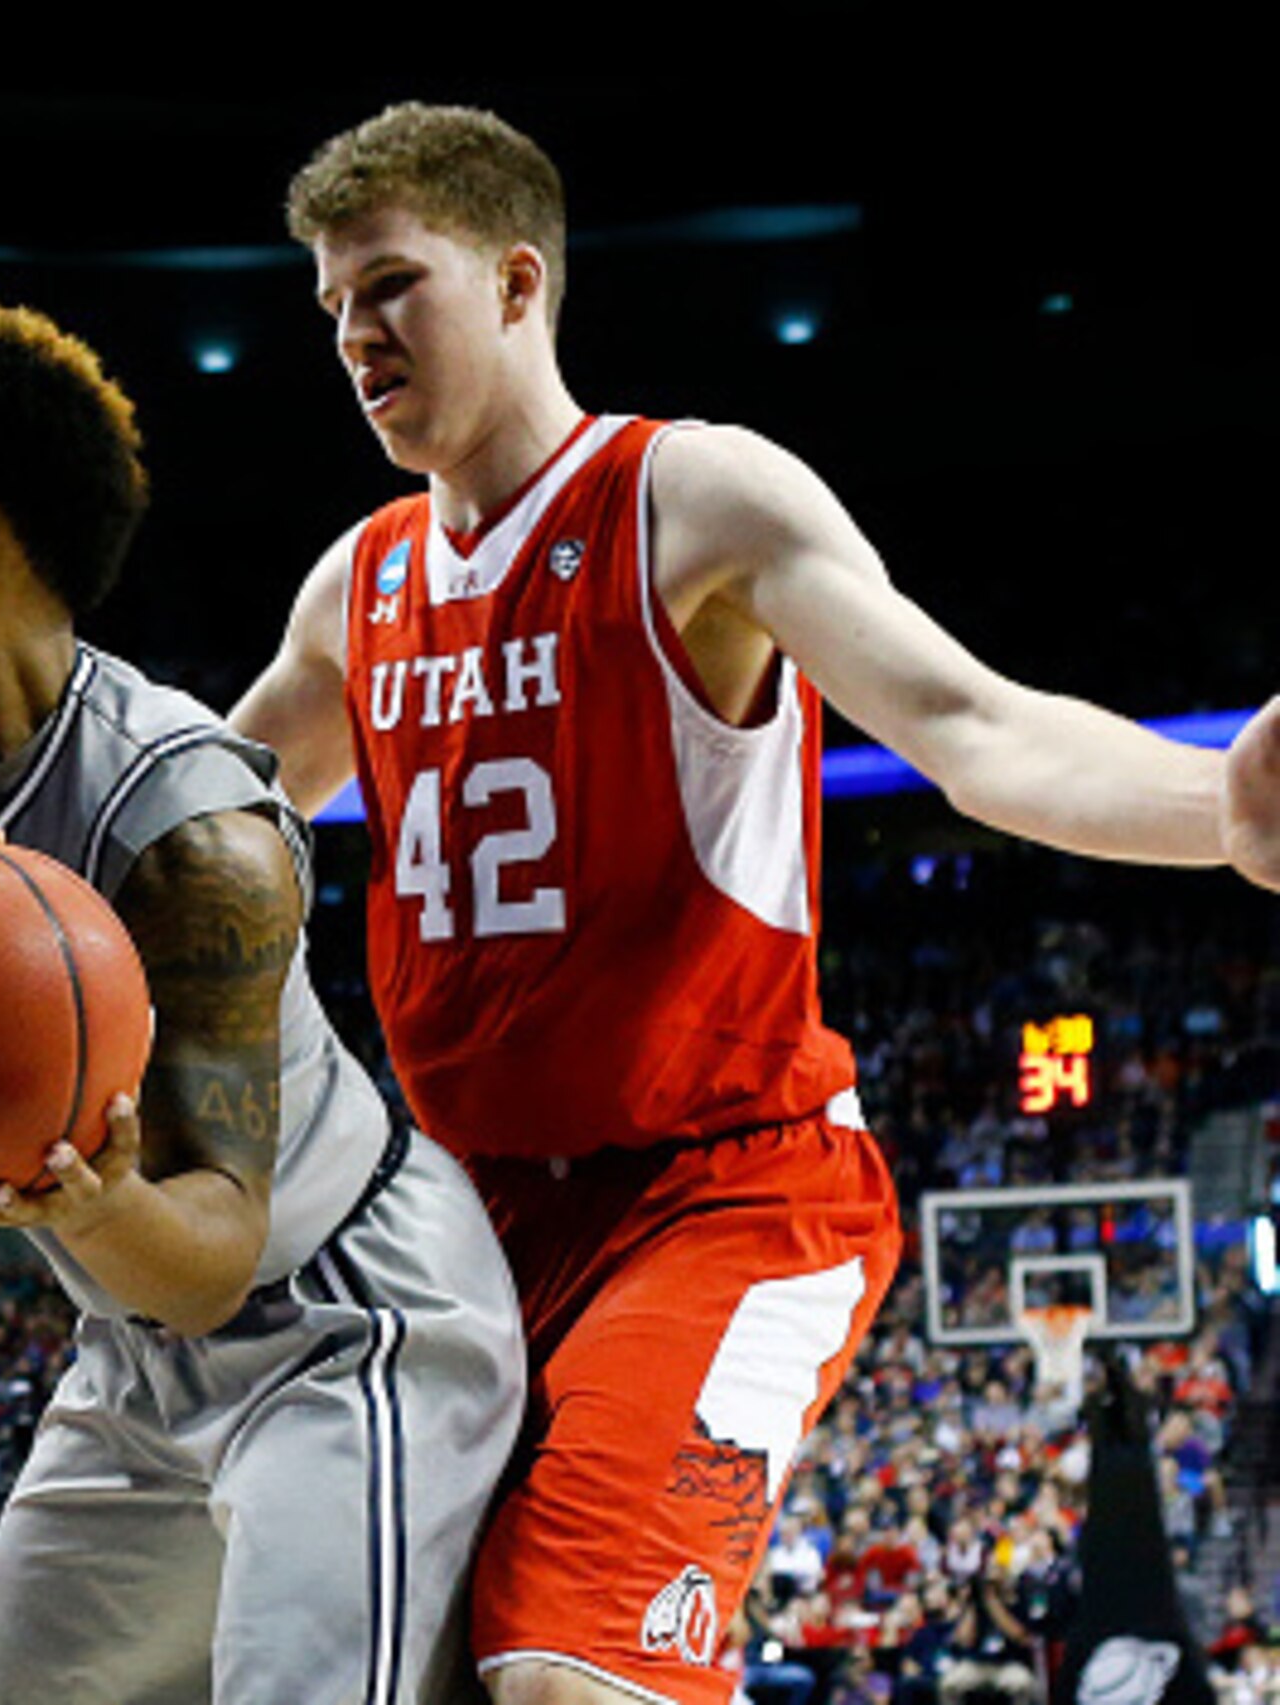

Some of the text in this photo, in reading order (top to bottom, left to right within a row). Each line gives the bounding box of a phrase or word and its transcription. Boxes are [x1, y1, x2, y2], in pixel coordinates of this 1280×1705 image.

[368, 632, 562, 732] UTAH
[395, 757, 566, 942] 42
[1019, 1053, 1089, 1114] 34
